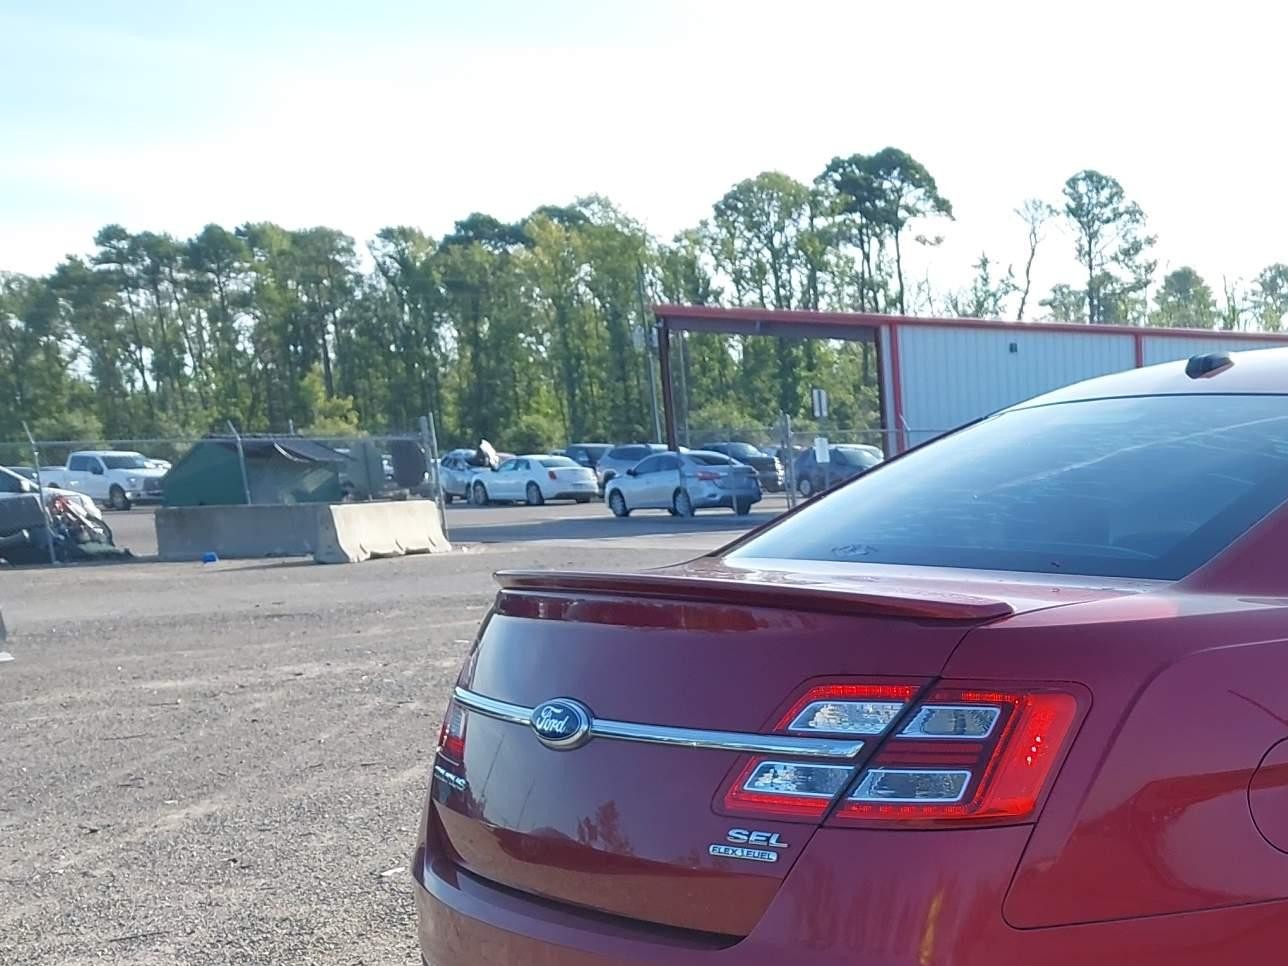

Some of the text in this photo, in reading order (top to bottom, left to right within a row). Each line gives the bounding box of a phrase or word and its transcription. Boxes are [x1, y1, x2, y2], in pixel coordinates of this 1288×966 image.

[536, 705, 569, 734] Ford
[726, 828, 788, 848] SEL
[711, 846, 738, 856] FLEX
